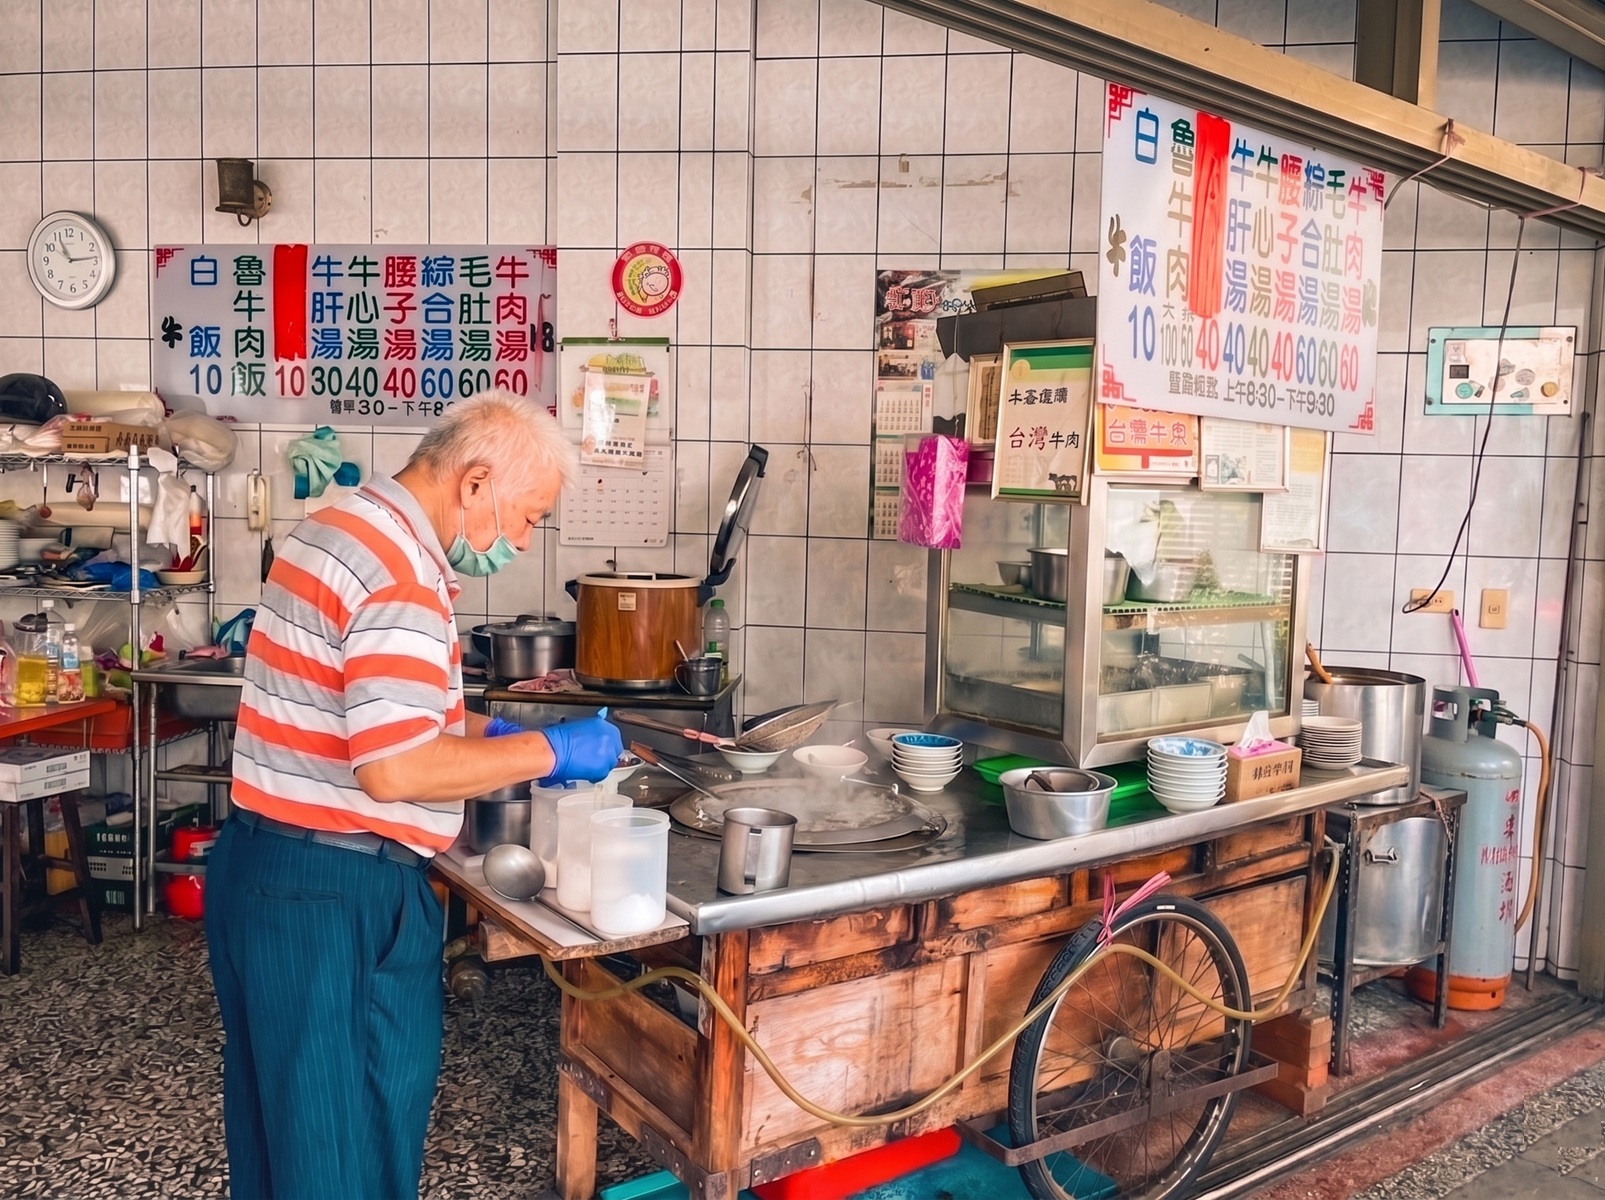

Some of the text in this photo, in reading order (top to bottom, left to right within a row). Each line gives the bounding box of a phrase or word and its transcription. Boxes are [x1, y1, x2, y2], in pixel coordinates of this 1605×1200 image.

[45, 243, 55, 252] 10
[65, 228, 74, 238] 12
[89, 242, 94, 252] 2
[1223, 138, 1254, 375] 牛肝湯 40
[43, 256, 49, 265] 9
[48, 270, 54, 278] 8
[58, 280, 63, 289] 7
[83, 280, 88, 289] 5
[90, 270, 96, 278] 4
[93, 256, 98, 265] 3
[1248, 145, 1278, 378] 牛心湯 40
[1296, 160, 1325, 384] 綜合湯 60
[1318, 170, 1345, 388] 毛肚湯 60
[1340, 176, 1367, 392] 牛肉湯 60
[70, 283, 76, 293] 6
[496, 256, 529, 362] 牛肉湯
[189, 255, 222, 396] 白飯 10
[231, 255, 266, 396] 魯牛肉飯
[311, 255, 344, 397] 牛肝湯 30
[346, 255, 380, 398] 牛心湯 40
[383, 255, 417, 398] 腰子湯 40
[421, 255, 455, 399] 綜合湯 60
[458, 255, 492, 397] 毛肚湯 60
[1128, 304, 1156, 360] 10
[1161, 324, 1178, 366] 100
[1181, 324, 1193, 368] 60
[1196, 319, 1220, 371] 40
[275, 366, 304, 397] 10
[1272, 332, 1294, 382] 40
[1010, 426, 1080, 450] 台灣牛肉
